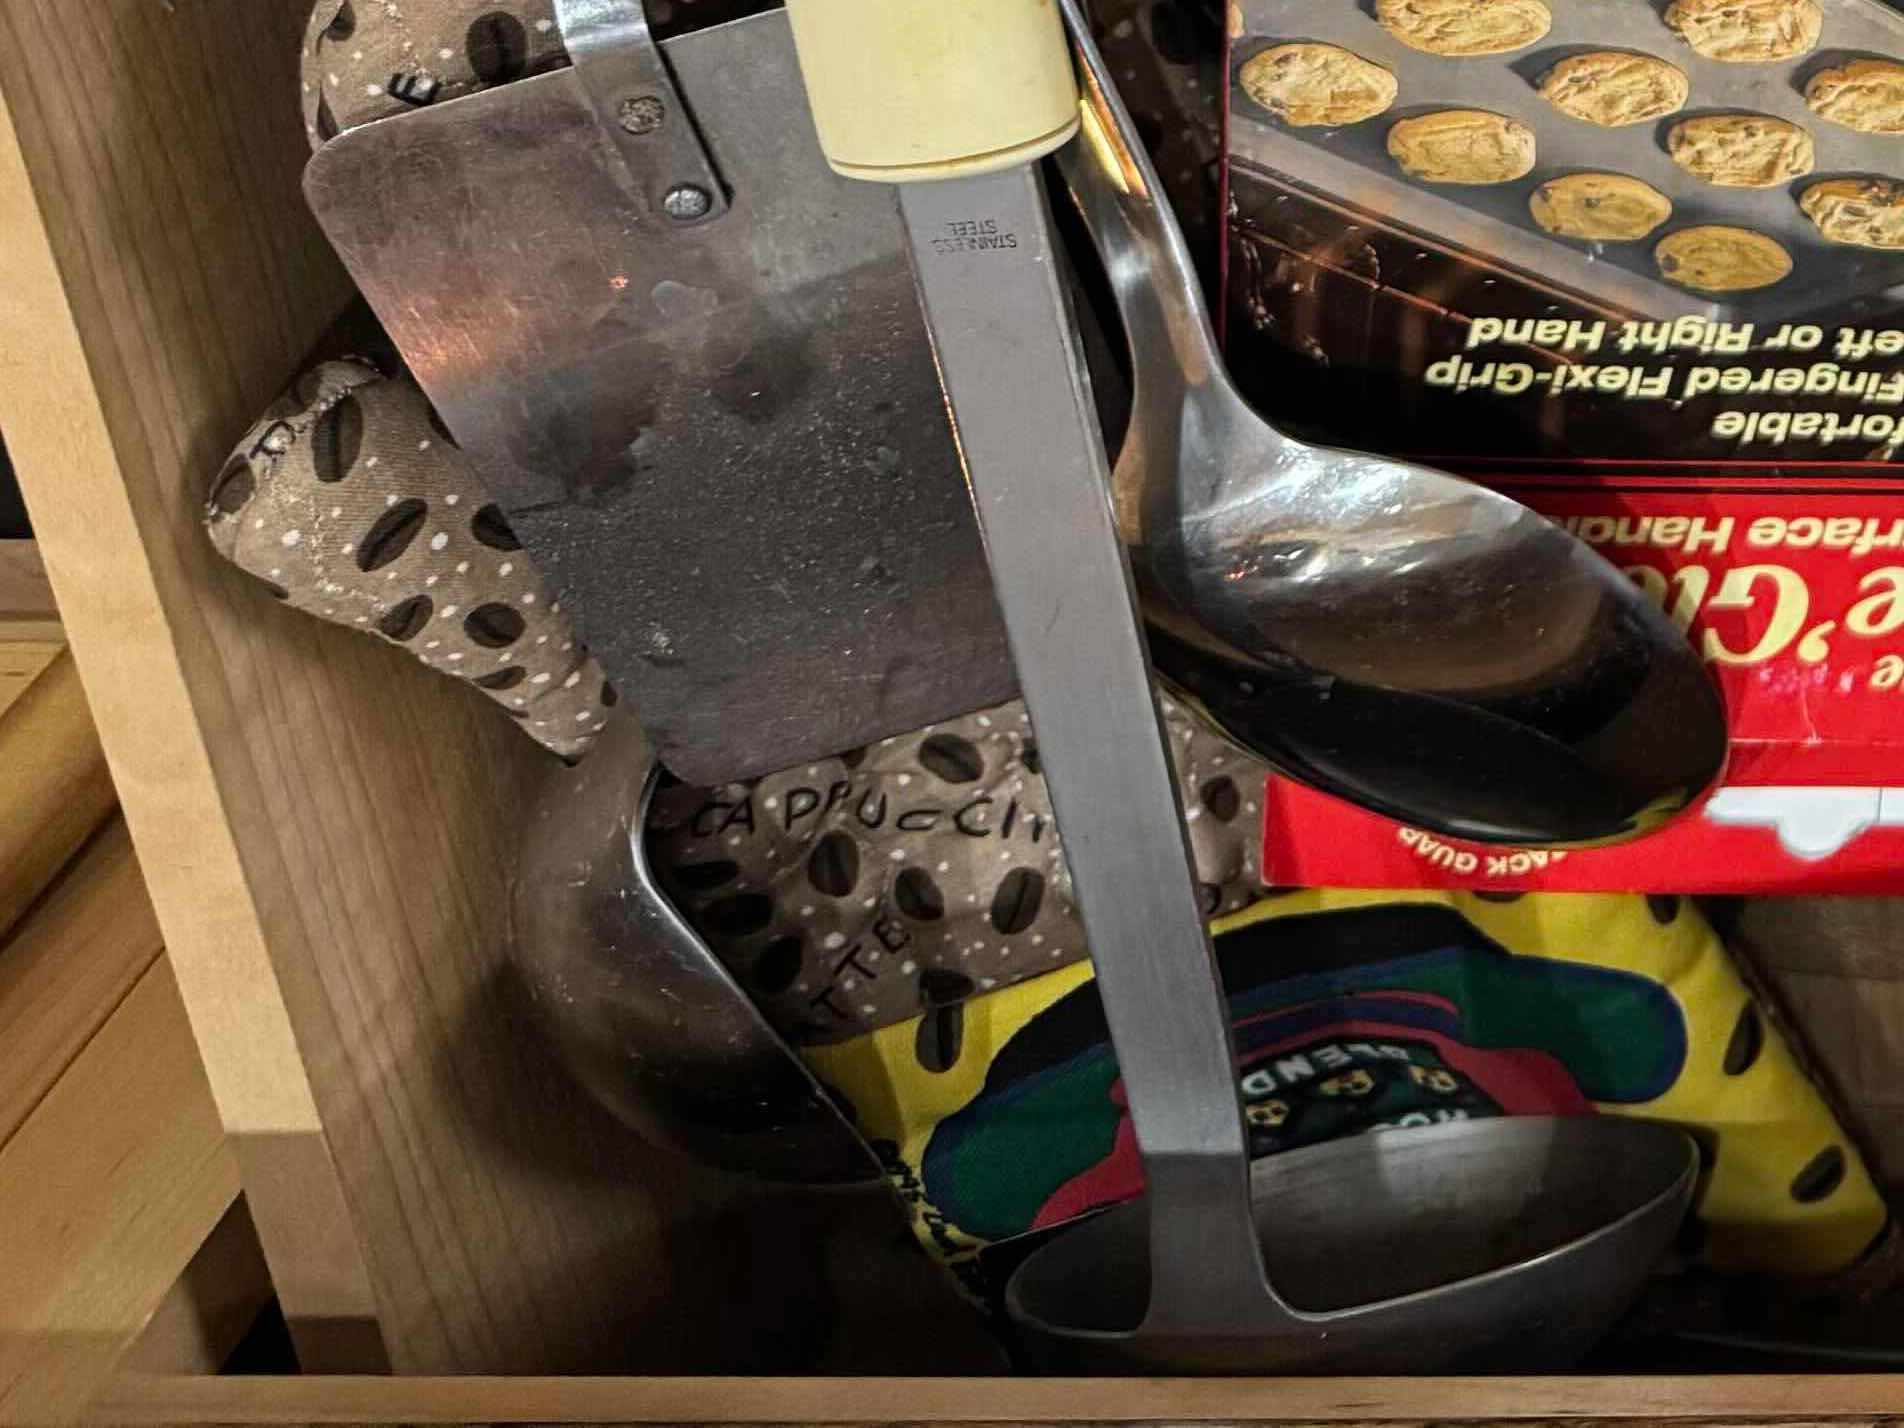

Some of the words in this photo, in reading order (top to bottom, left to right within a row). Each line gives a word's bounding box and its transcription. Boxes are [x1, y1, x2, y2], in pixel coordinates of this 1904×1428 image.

[1466, 315, 1607, 348] Hand
[1613, 316, 1754, 354] Right
[1766, 322, 1821, 349] or
[1425, 354, 1673, 399] Flexi-Grip
